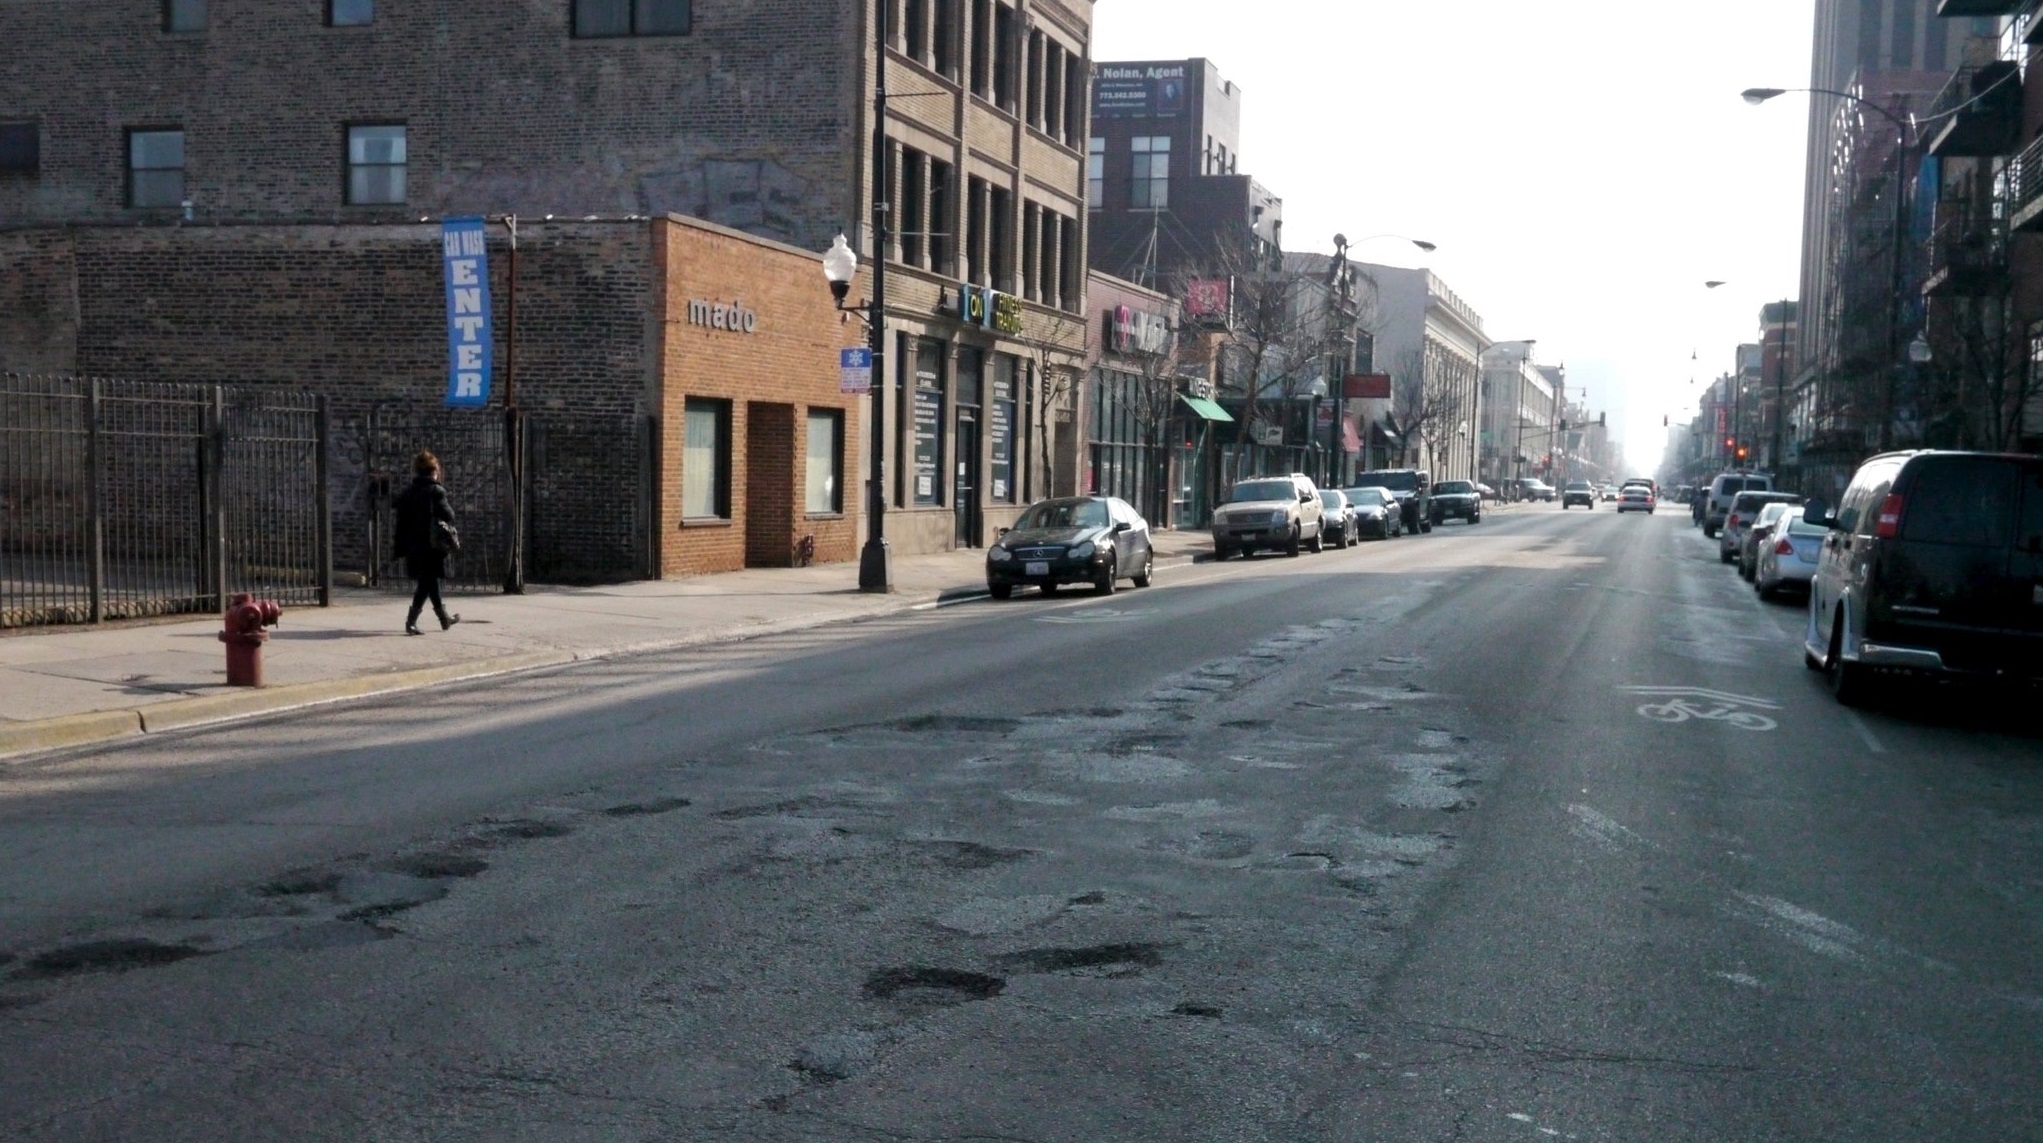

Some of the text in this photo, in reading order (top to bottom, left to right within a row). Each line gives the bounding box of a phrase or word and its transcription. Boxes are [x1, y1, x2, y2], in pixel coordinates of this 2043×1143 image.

[1103, 67, 1143, 79] Nolan,
[1146, 66, 1184, 79] Agent
[688, 299, 756, 334] mado
[970, 294, 984, 318] ON
[451, 259, 484, 397] ENTER
